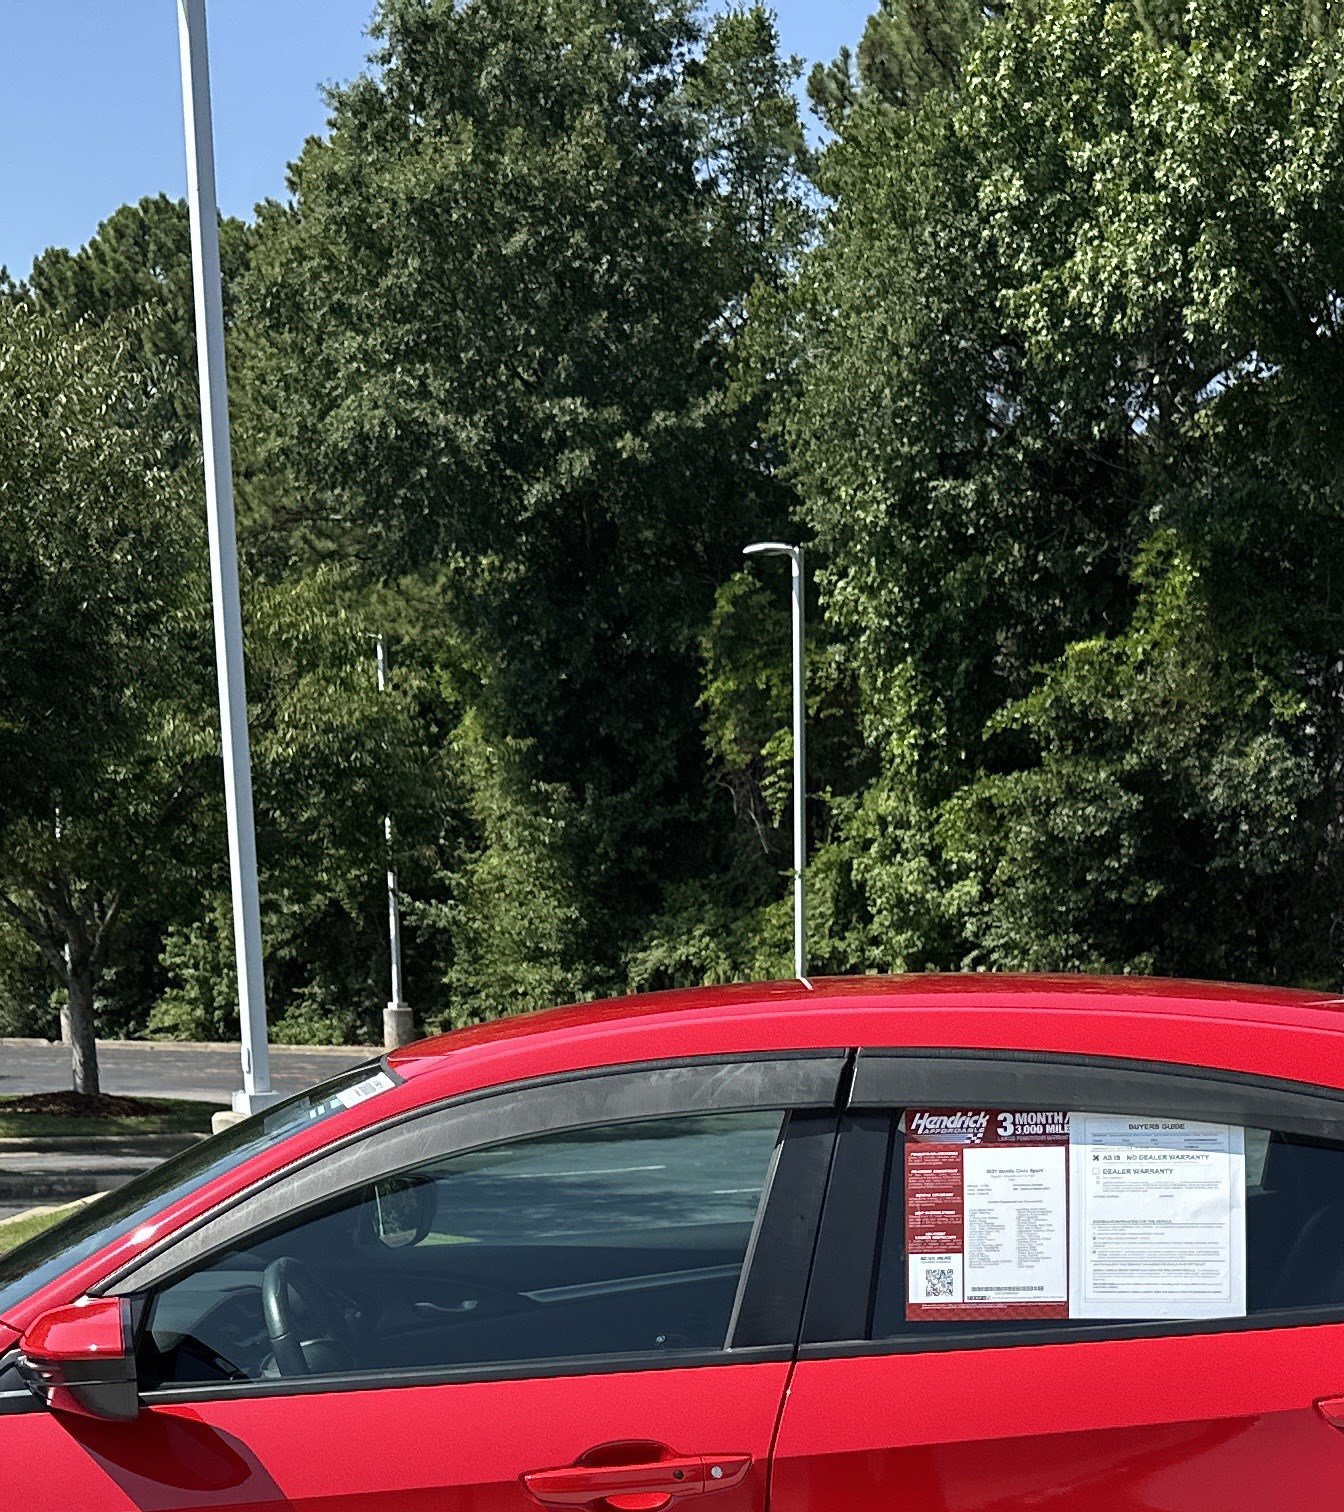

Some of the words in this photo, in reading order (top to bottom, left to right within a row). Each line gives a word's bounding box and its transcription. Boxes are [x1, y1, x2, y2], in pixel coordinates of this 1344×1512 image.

[911, 1111, 990, 1134] Hendrick
[997, 1112, 1014, 1136] 3
[1015, 1124, 1043, 1135] 3,000
